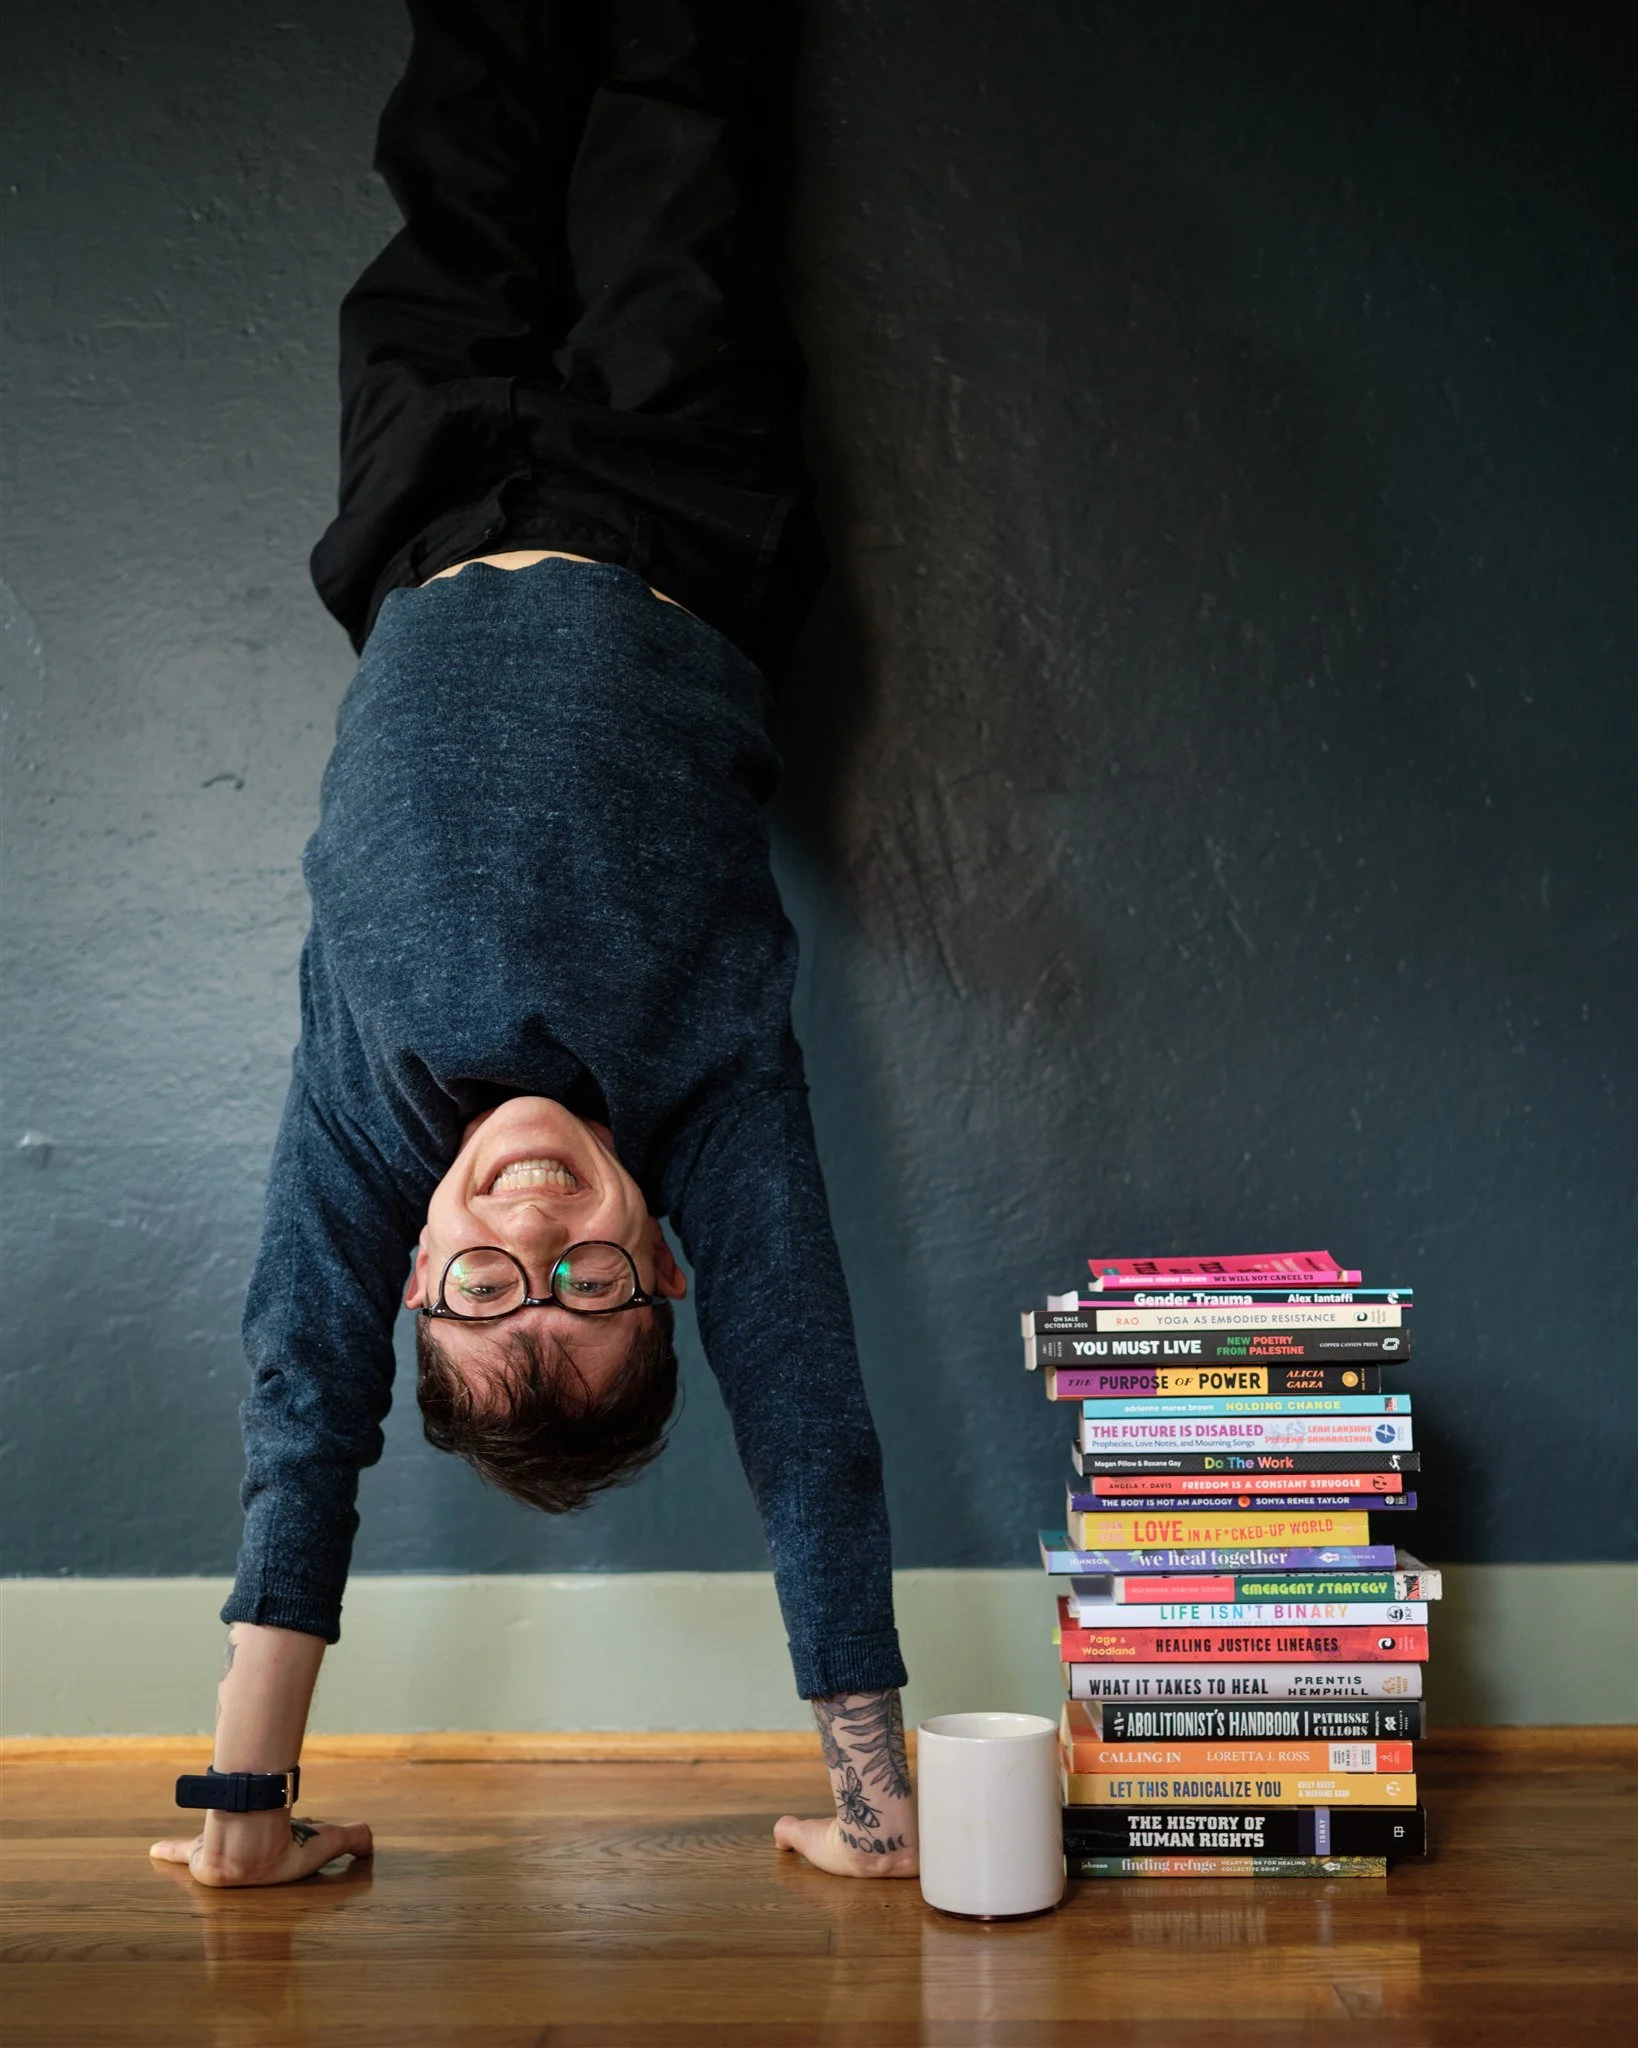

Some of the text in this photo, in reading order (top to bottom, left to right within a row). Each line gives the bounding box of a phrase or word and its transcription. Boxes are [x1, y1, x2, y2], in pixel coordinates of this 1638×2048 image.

[1119, 1276, 1154, 1284] adrienne
[1134, 1293, 1252, 1307] Gender Trauma
[1288, 1293, 1354, 1303] Alex Iantaffi
[1156, 1314, 1336, 1325] YOGA AS EMBODIED RESISTANCE
[1227, 1336, 1294, 1345] NEW POETRY
[1072, 1342, 1108, 1356] YOU
[1112, 1341, 1160, 1355] MUST
[1164, 1340, 1202, 1354] LIVE
[1216, 1346, 1304, 1356] FROM PALESTINE
[1286, 1370, 1324, 1378] ALICIA
[1100, 1376, 1168, 1390] PURPOSE
[1175, 1377, 1193, 1386] OF
[1199, 1373, 1261, 1389] POWER
[1286, 1380, 1323, 1388] GARZA
[1124, 1404, 1159, 1412] adrienne
[1226, 1401, 1341, 1411] HOLDING CHANGE
[1092, 1424, 1264, 1438] THE FUTURE IS DISABLED
[1092, 1440, 1134, 1449] Prophecies,
[1155, 1440, 1178, 1448] Notes,
[1196, 1439, 1231, 1448] Mourning
[1233, 1439, 1255, 1447] Songs
[1095, 1460, 1117, 1468] Megan
[1168, 1460, 1181, 1468] Gay
[1204, 1456, 1294, 1469] Do The Work
[1182, 1479, 1360, 1489] FREEDOM IS A CONSTANT STRUGGLE
[1102, 1499, 1119, 1507] THE
[1177, 1498, 1190, 1506] AN
[1192, 1498, 1233, 1506] APOLOGY
[1134, 1520, 1183, 1542] LOVE
[1188, 1530, 1200, 1542] IN
[1204, 1529, 1214, 1541] A
[1290, 1519, 1334, 1535] WORLD
[1139, 1550, 1288, 1568] we heal together
[1241, 1582, 1388, 1595] EMERGENT STRATEGY
[1161, 1604, 1348, 1620] LIFE ISN'T BINARY
[1090, 1636, 1117, 1646] Page
[1156, 1638, 1338, 1652] HEALING JUSTICE LINEAGES
[1082, 1646, 1136, 1656] Woodland
[1294, 1676, 1362, 1685] PRENTIS
[1089, 1679, 1268, 1696] WHAT IT TAKES TO HEAL
[1288, 1688, 1368, 1696] HEMPHILL
[1127, 1709, 1225, 1737] ABOLITIONIST'S
[1229, 1711, 1299, 1736] HANDBOOK
[1313, 1712, 1370, 1724] PATRISSE
[1314, 1726, 1368, 1736] CULLORS
[1100, 1752, 1181, 1763] CALLING IN
[1207, 1751, 1310, 1762] LORETTA J. ROSS
[1110, 1781, 1281, 1798] LET THIS RADICALIZE YOU
[1128, 1816, 1265, 1830] THE HISTORY OF
[1129, 1832, 1264, 1848] HUMAN RIGHTS
[1081, 1862, 1108, 1870] johnson
[1121, 1858, 1216, 1873] finding refuge
